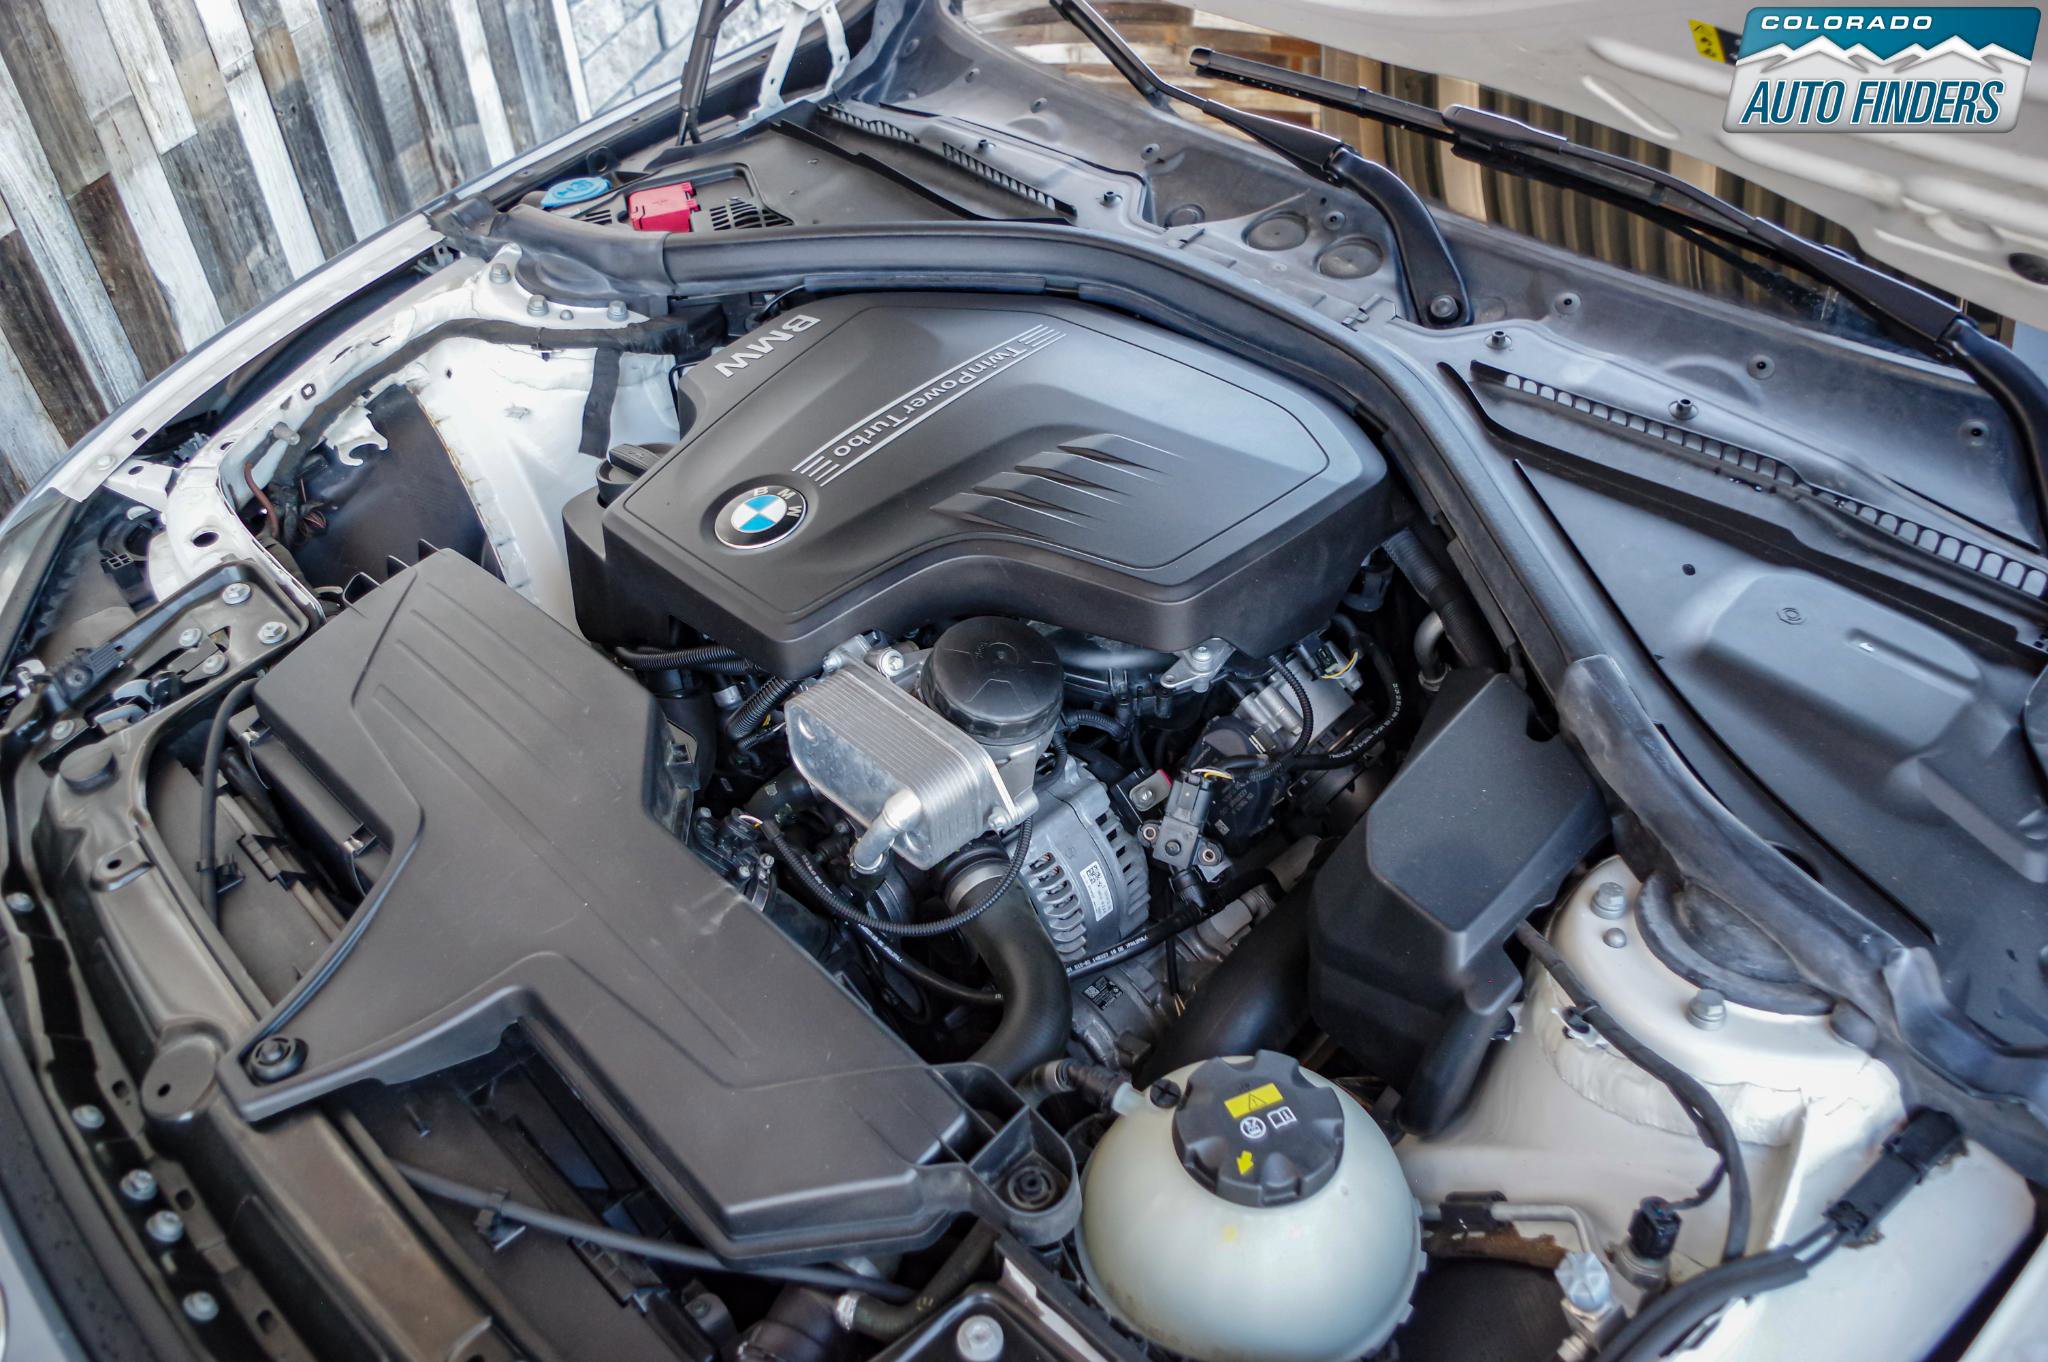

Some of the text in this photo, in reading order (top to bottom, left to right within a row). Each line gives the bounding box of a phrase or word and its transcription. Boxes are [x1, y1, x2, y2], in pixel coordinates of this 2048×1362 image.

[714, 314, 821, 378] BMW
[833, 342, 1028, 458] TwinPower Turbo
[753, 486, 802, 517] BMW
